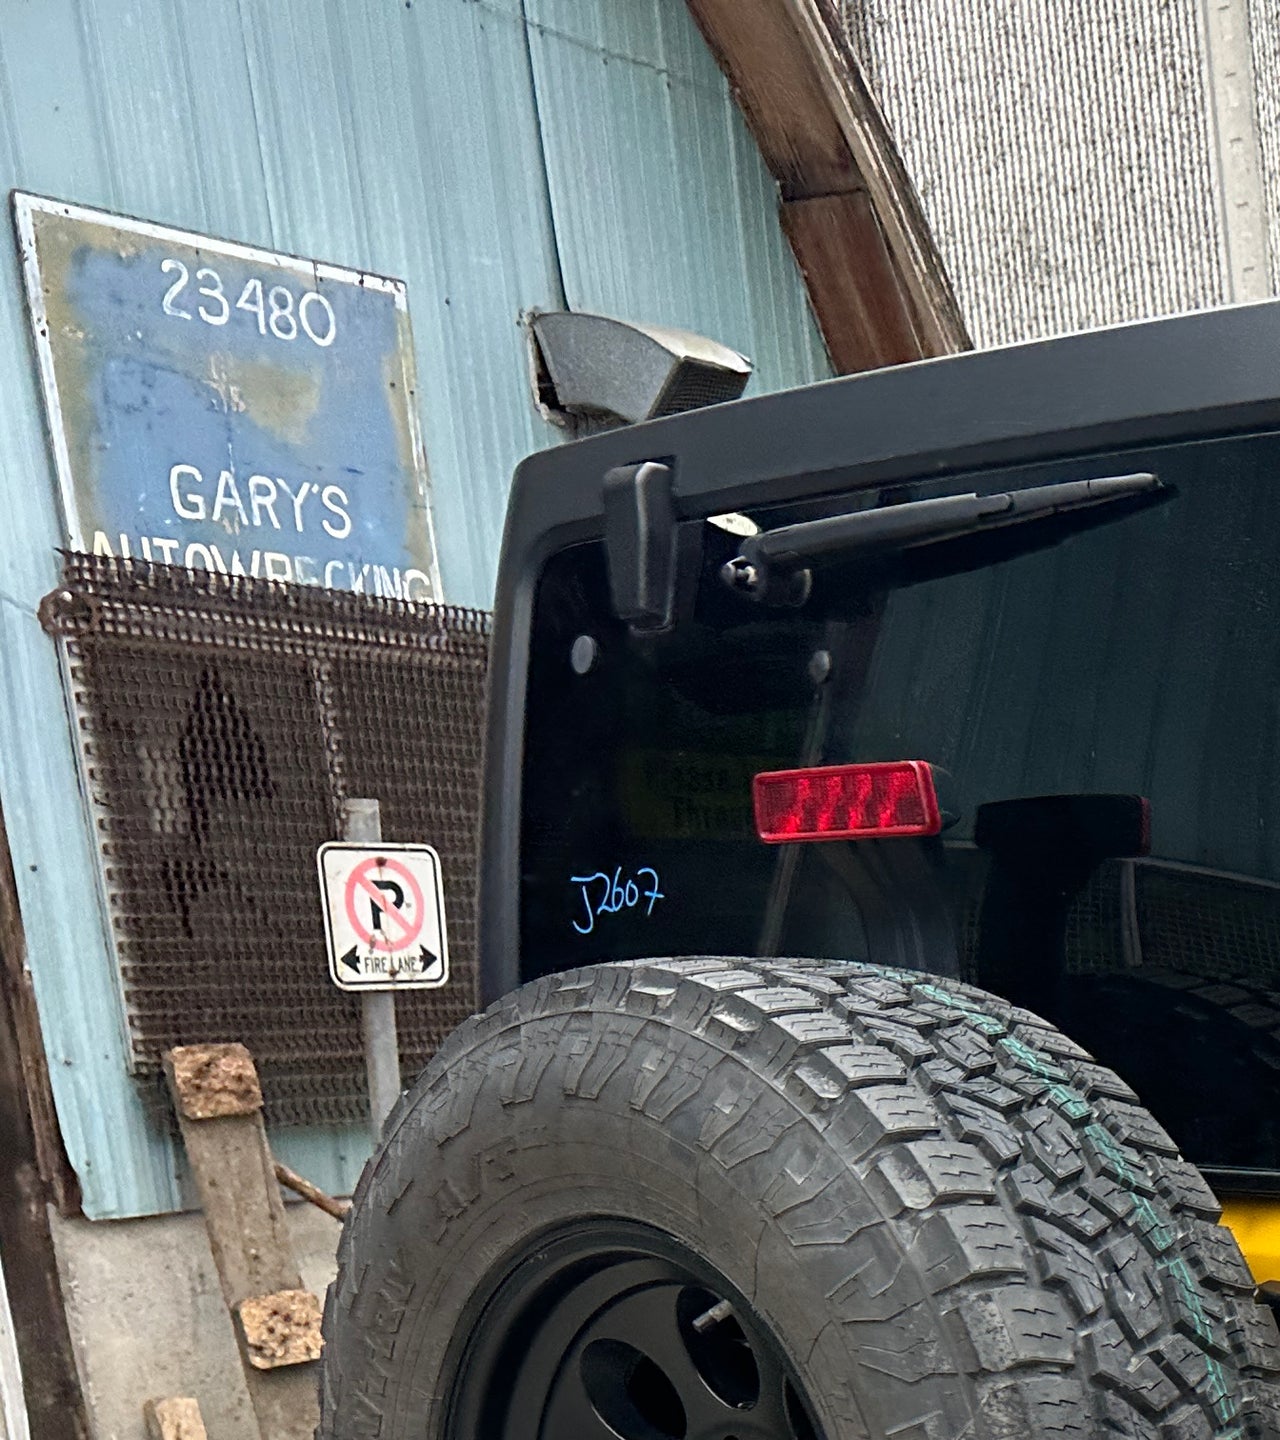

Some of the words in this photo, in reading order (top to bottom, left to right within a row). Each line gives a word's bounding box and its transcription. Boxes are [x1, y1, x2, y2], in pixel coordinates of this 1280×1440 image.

[161, 258, 337, 347] 23480
[169, 463, 352, 540] GARY'S
[570, 866, 665, 934] J2607
[364, 956, 388, 974] FIRE
[390, 955, 420, 974] LANE
